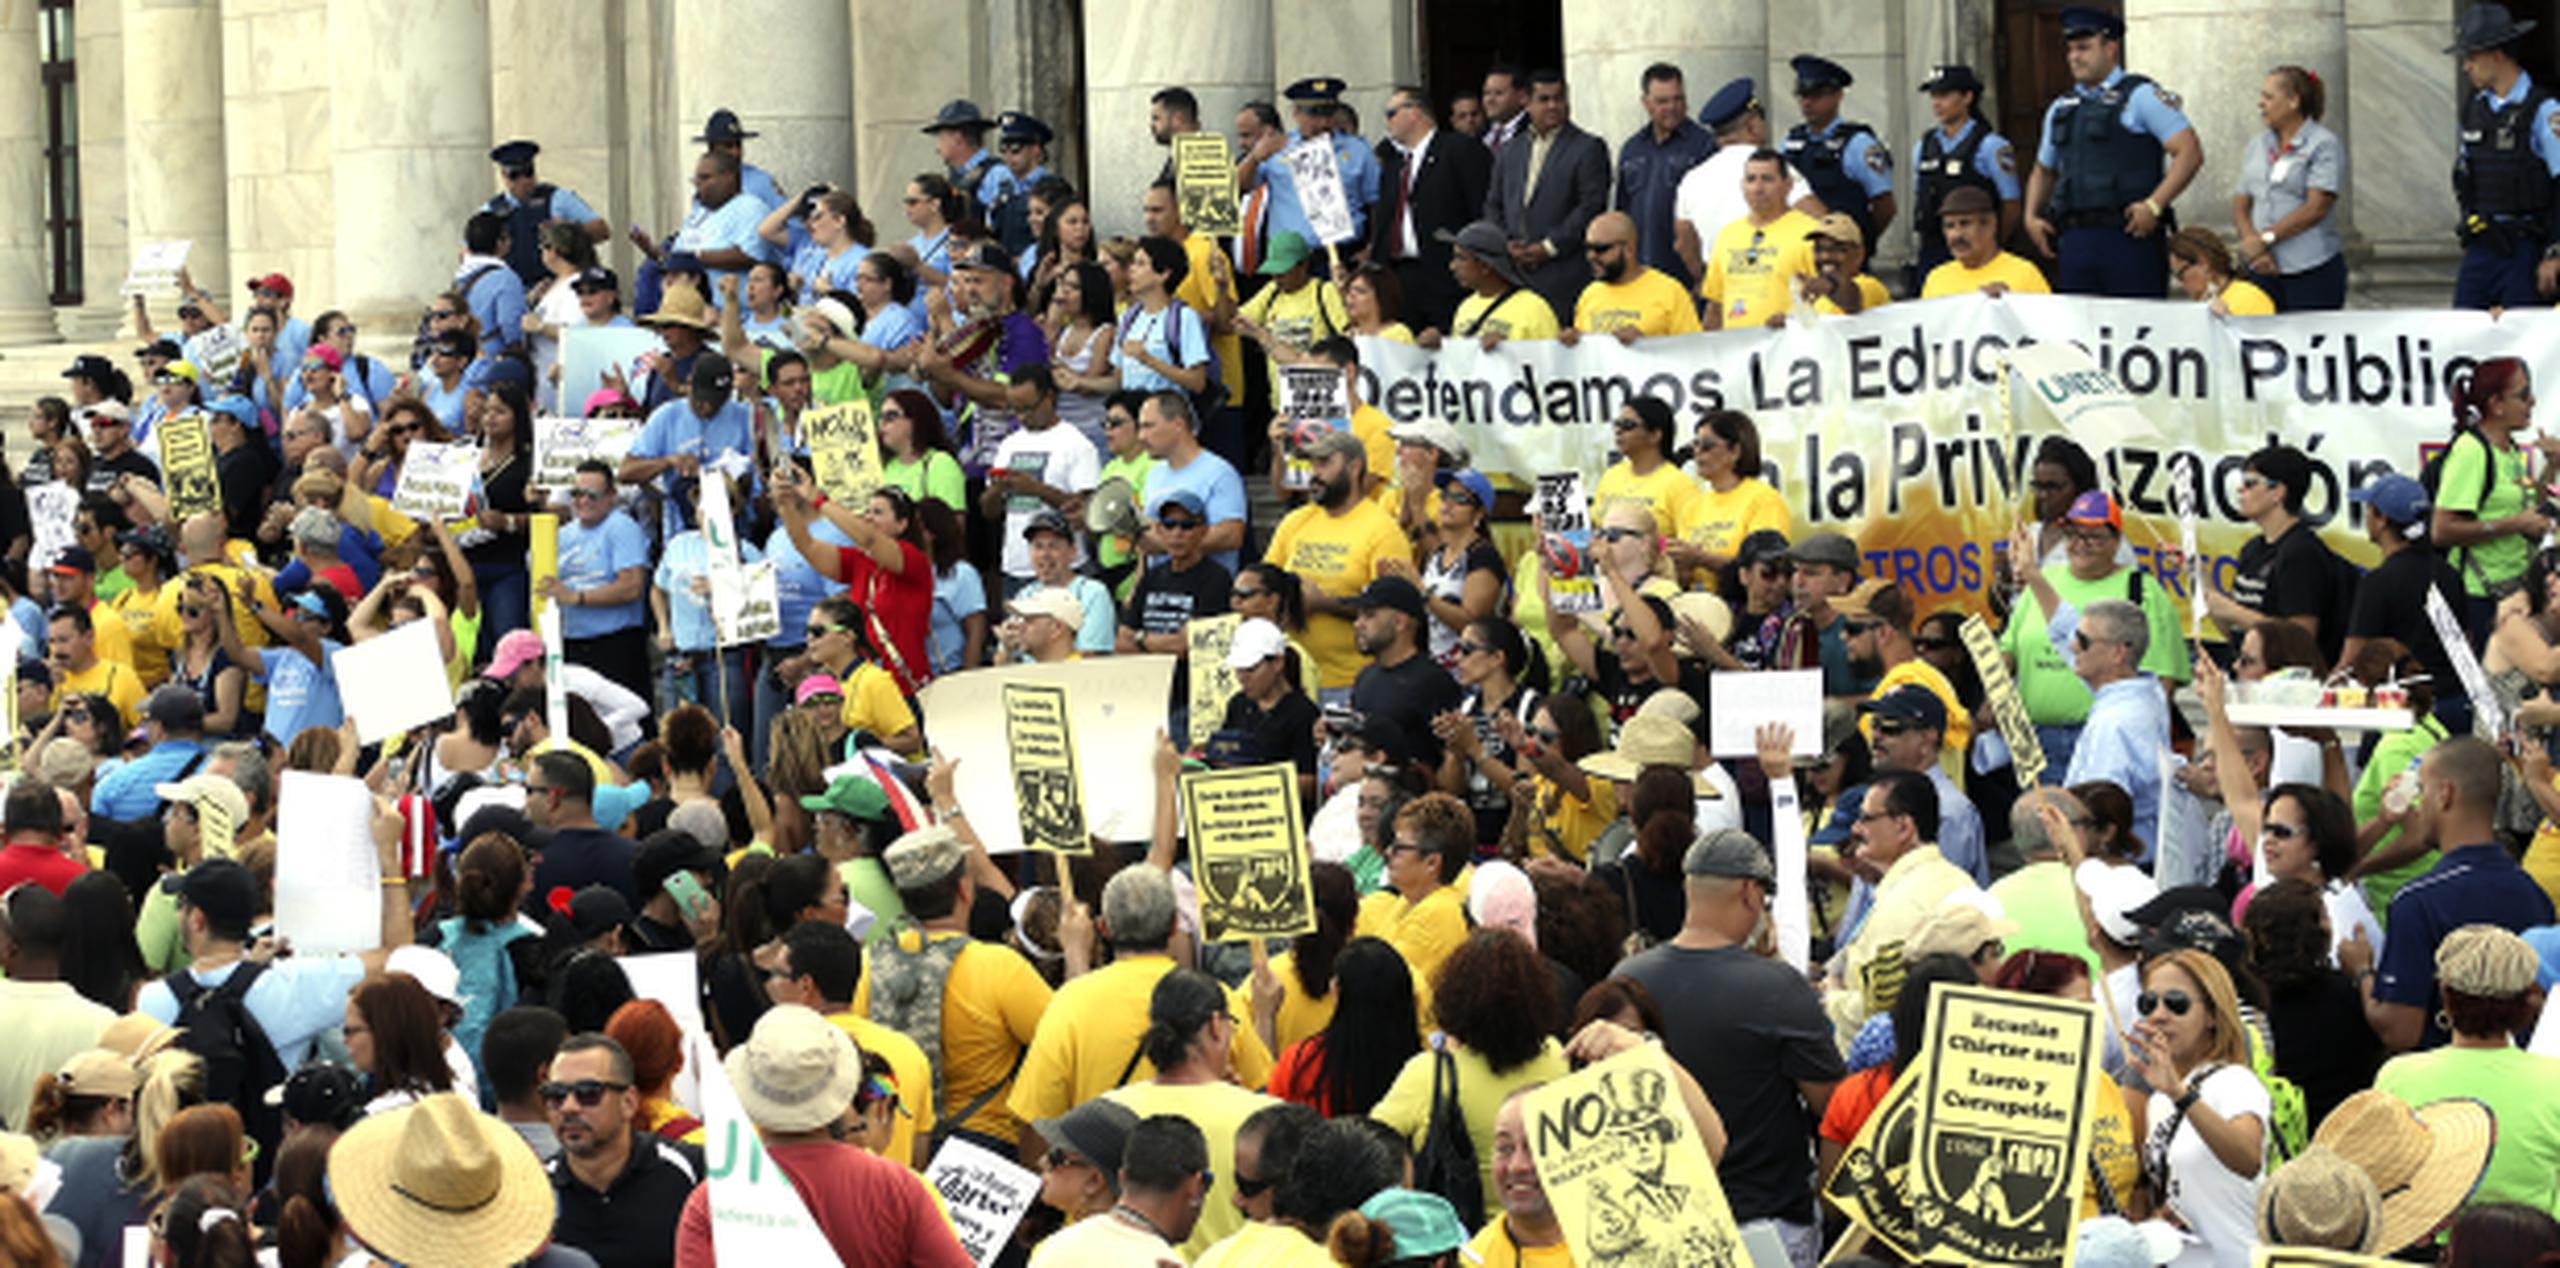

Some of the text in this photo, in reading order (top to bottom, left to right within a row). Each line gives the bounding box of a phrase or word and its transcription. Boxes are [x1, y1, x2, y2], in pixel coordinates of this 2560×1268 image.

[1356, 362, 1724, 424] Defendamos
[1749, 352, 1822, 410] La
[1849, 325, 2208, 400] Edución
[2240, 334, 2478, 406] Públic
[1806, 416, 2396, 531] la Privizacón
[1537, 1092, 1607, 1158] NO
